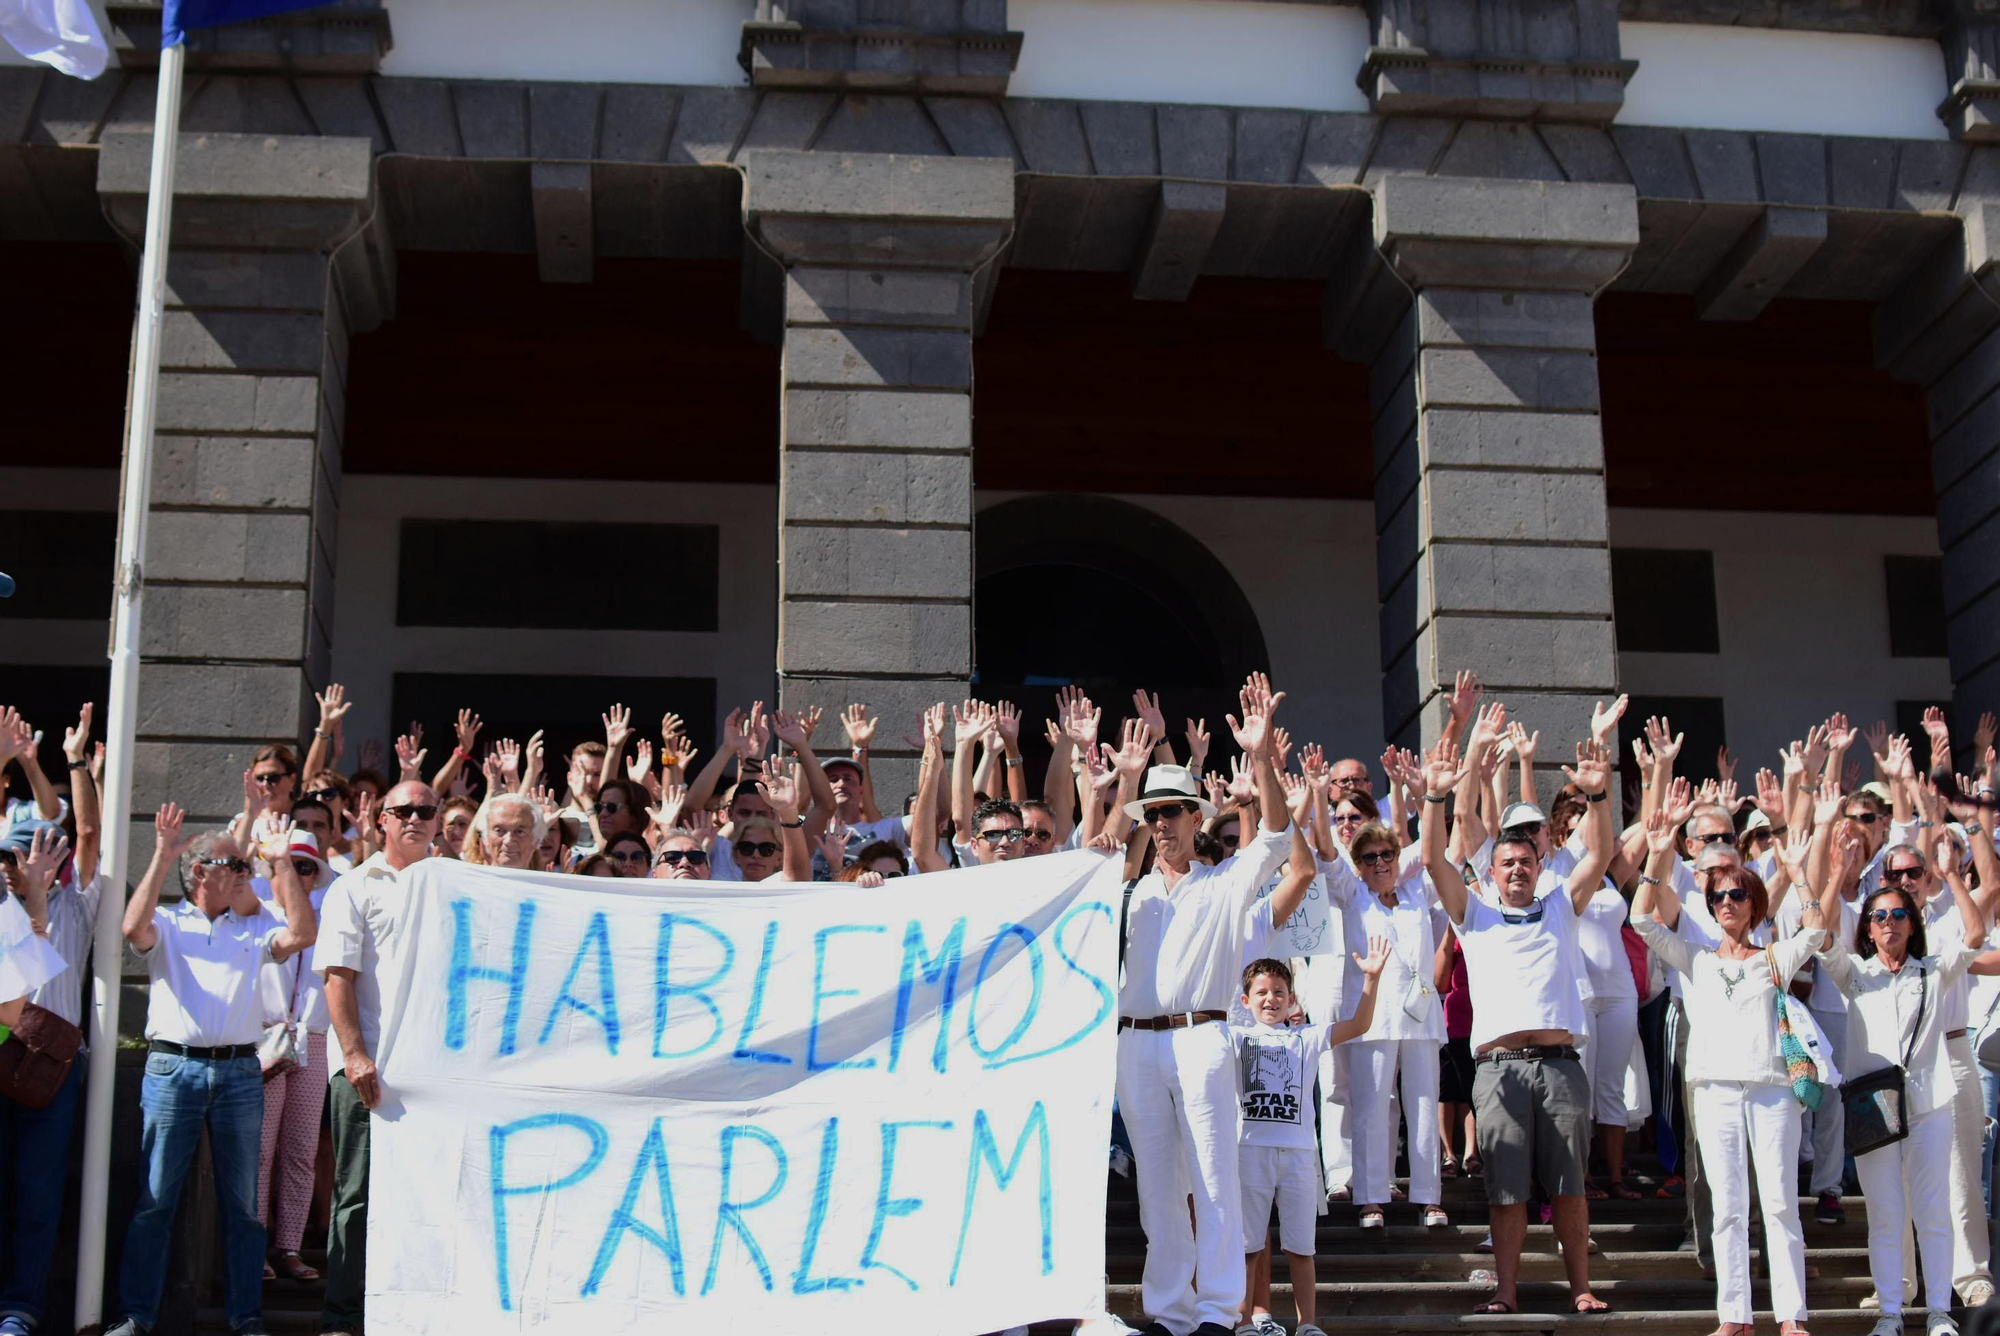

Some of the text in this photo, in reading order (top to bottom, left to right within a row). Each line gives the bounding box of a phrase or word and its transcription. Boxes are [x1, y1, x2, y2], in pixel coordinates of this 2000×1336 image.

[444, 898, 1114, 1073] HABLEMOS
[1243, 1093, 1299, 1108] STAR
[1246, 1105, 1299, 1121] WARS
[489, 1101, 1054, 1312] PARLEM
